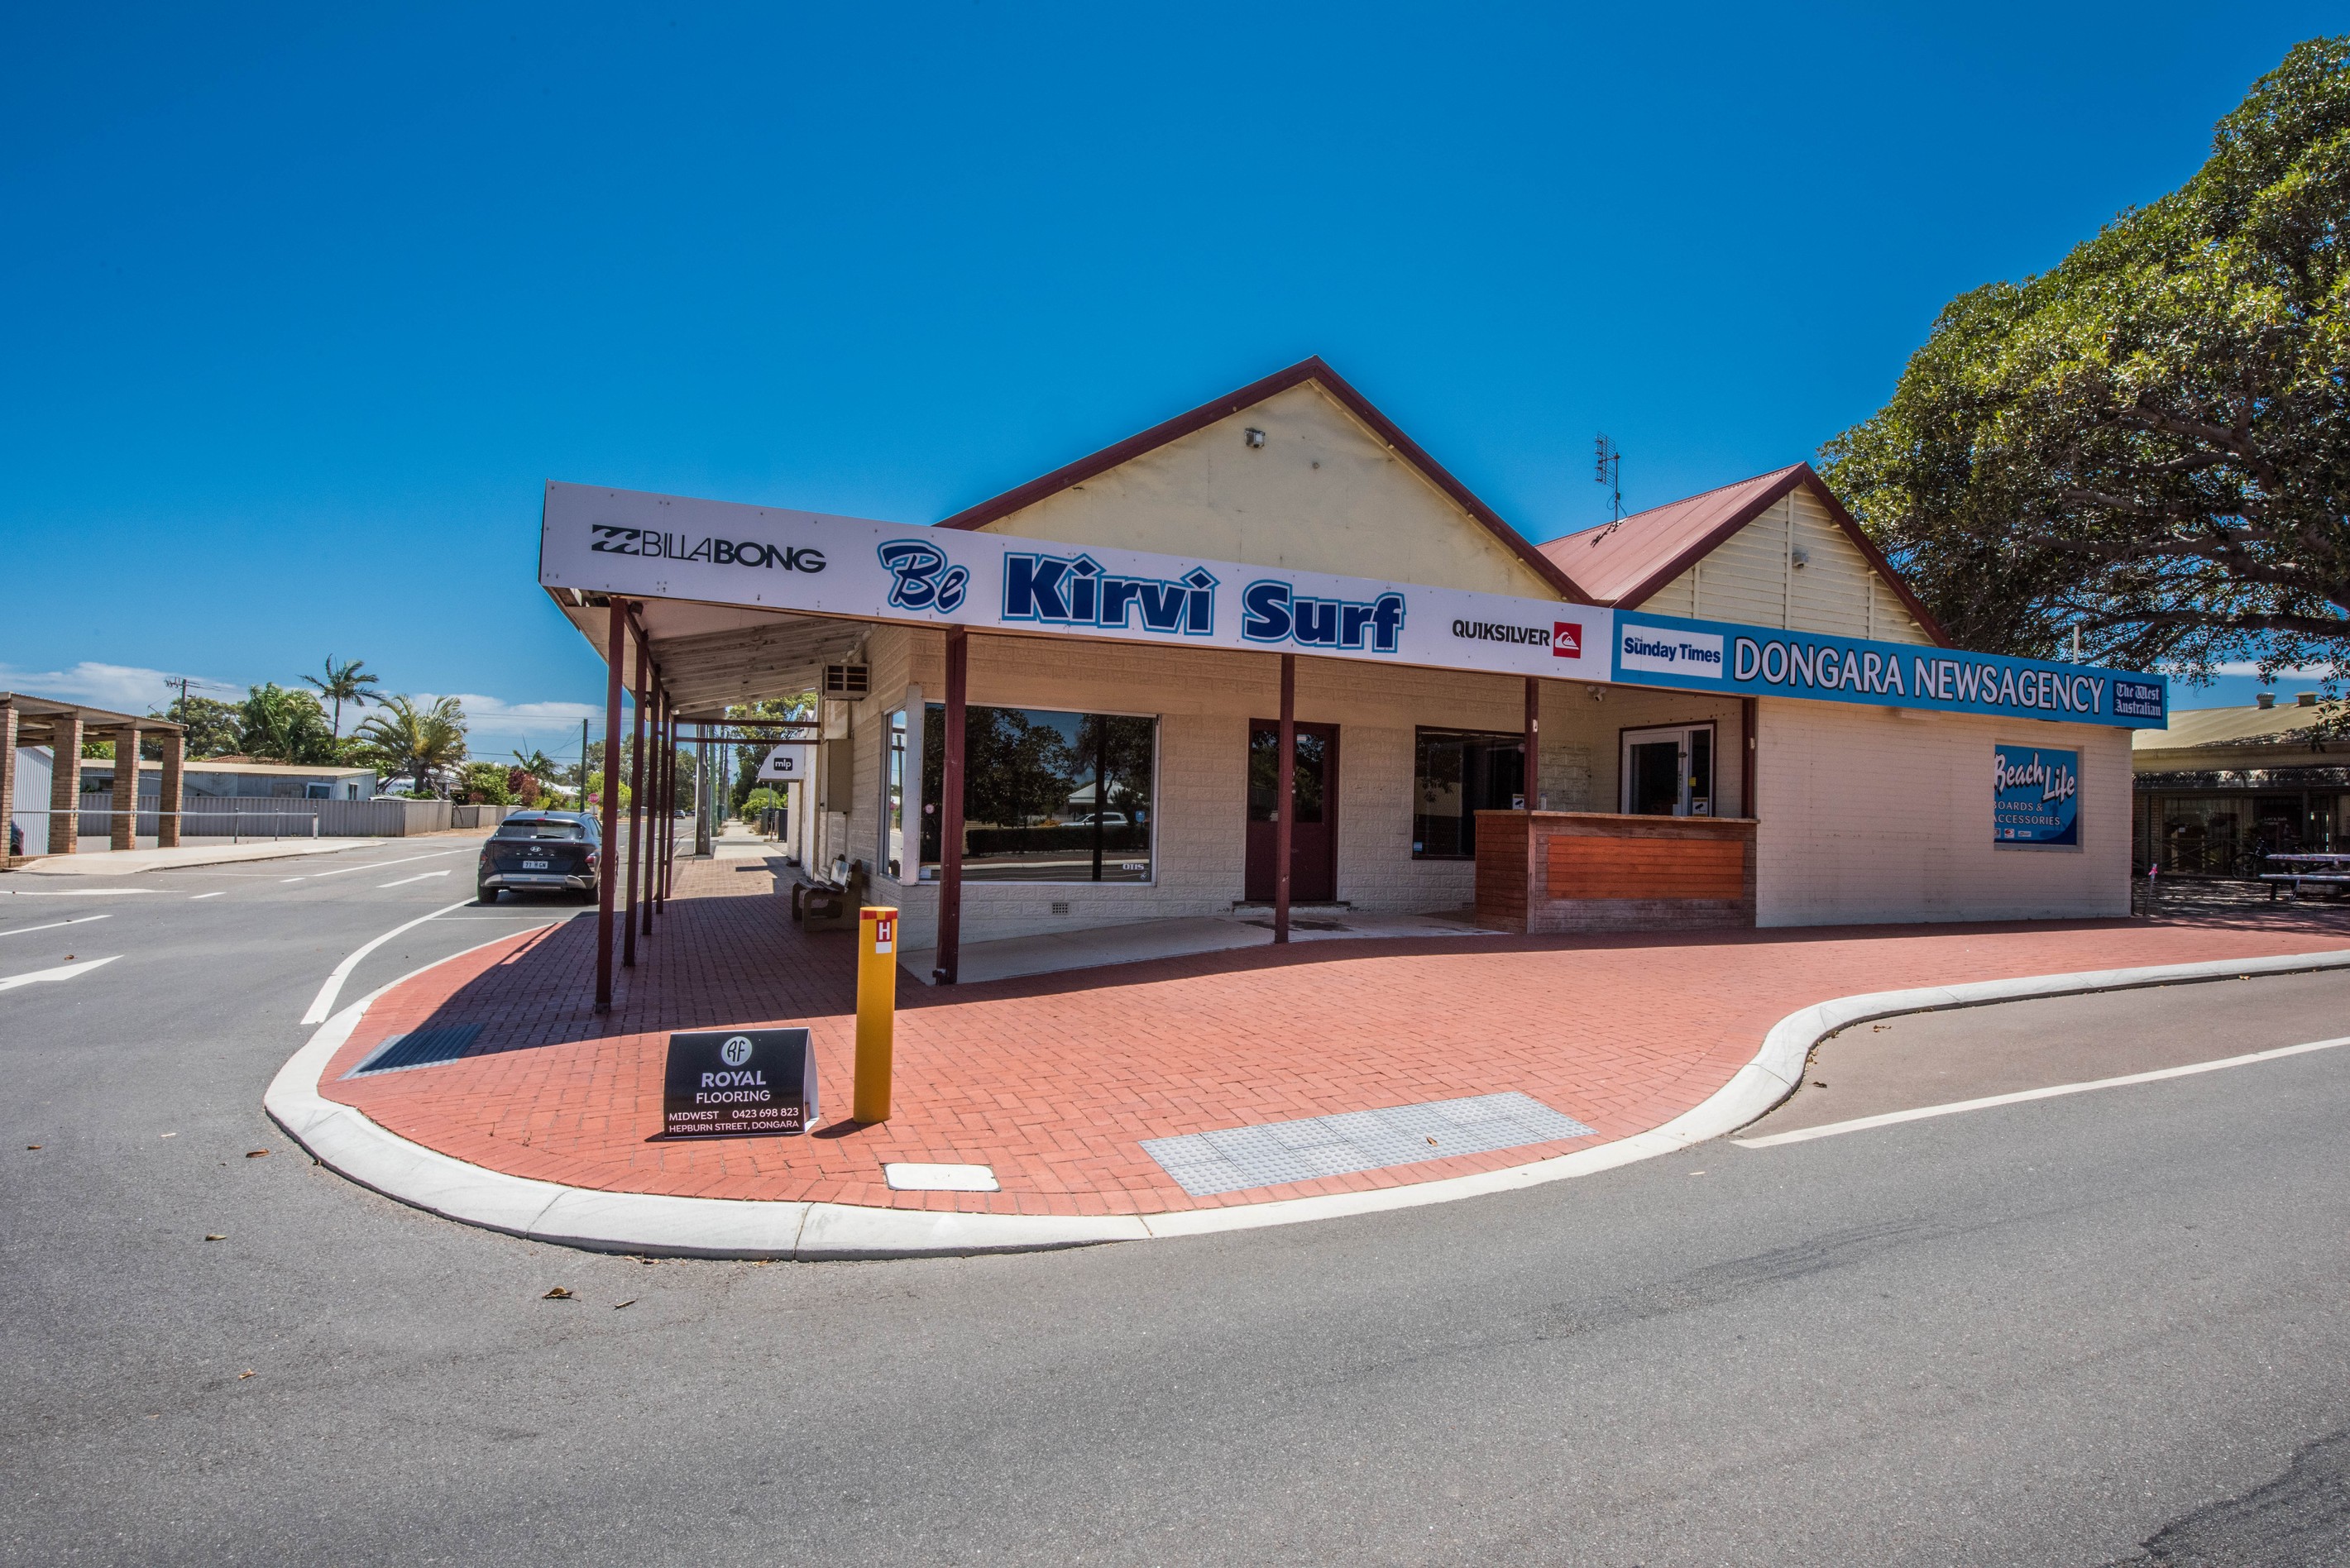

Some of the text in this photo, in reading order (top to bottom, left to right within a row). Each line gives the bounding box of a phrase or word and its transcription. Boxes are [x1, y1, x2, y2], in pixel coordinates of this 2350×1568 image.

[642, 530, 826, 573] BILLABONG
[877, 538, 1405, 653] Be Kirvi Surf
[1451, 619, 1551, 648] QUIKSILVER
[1624, 637, 1677, 662] Sunday
[1679, 643, 1721, 663] Times
[1734, 637, 2105, 715] DONGARA NEWSAGENCY
[2116, 682, 2160, 700] The West
[2114, 699, 2161, 717] Australian
[774, 758, 792, 770] mlp
[1994, 751, 2075, 806] Beach Life
[2036, 803, 2043, 812] &
[878, 922, 890, 940] H
[701, 1070, 766, 1088] ROYAL
[696, 1090, 771, 1104] FLOORING
[668, 1107, 799, 1121] MIDWEST 0423 698 823
[668, 1120, 799, 1133] HEPBURN STREET, DONGARA
